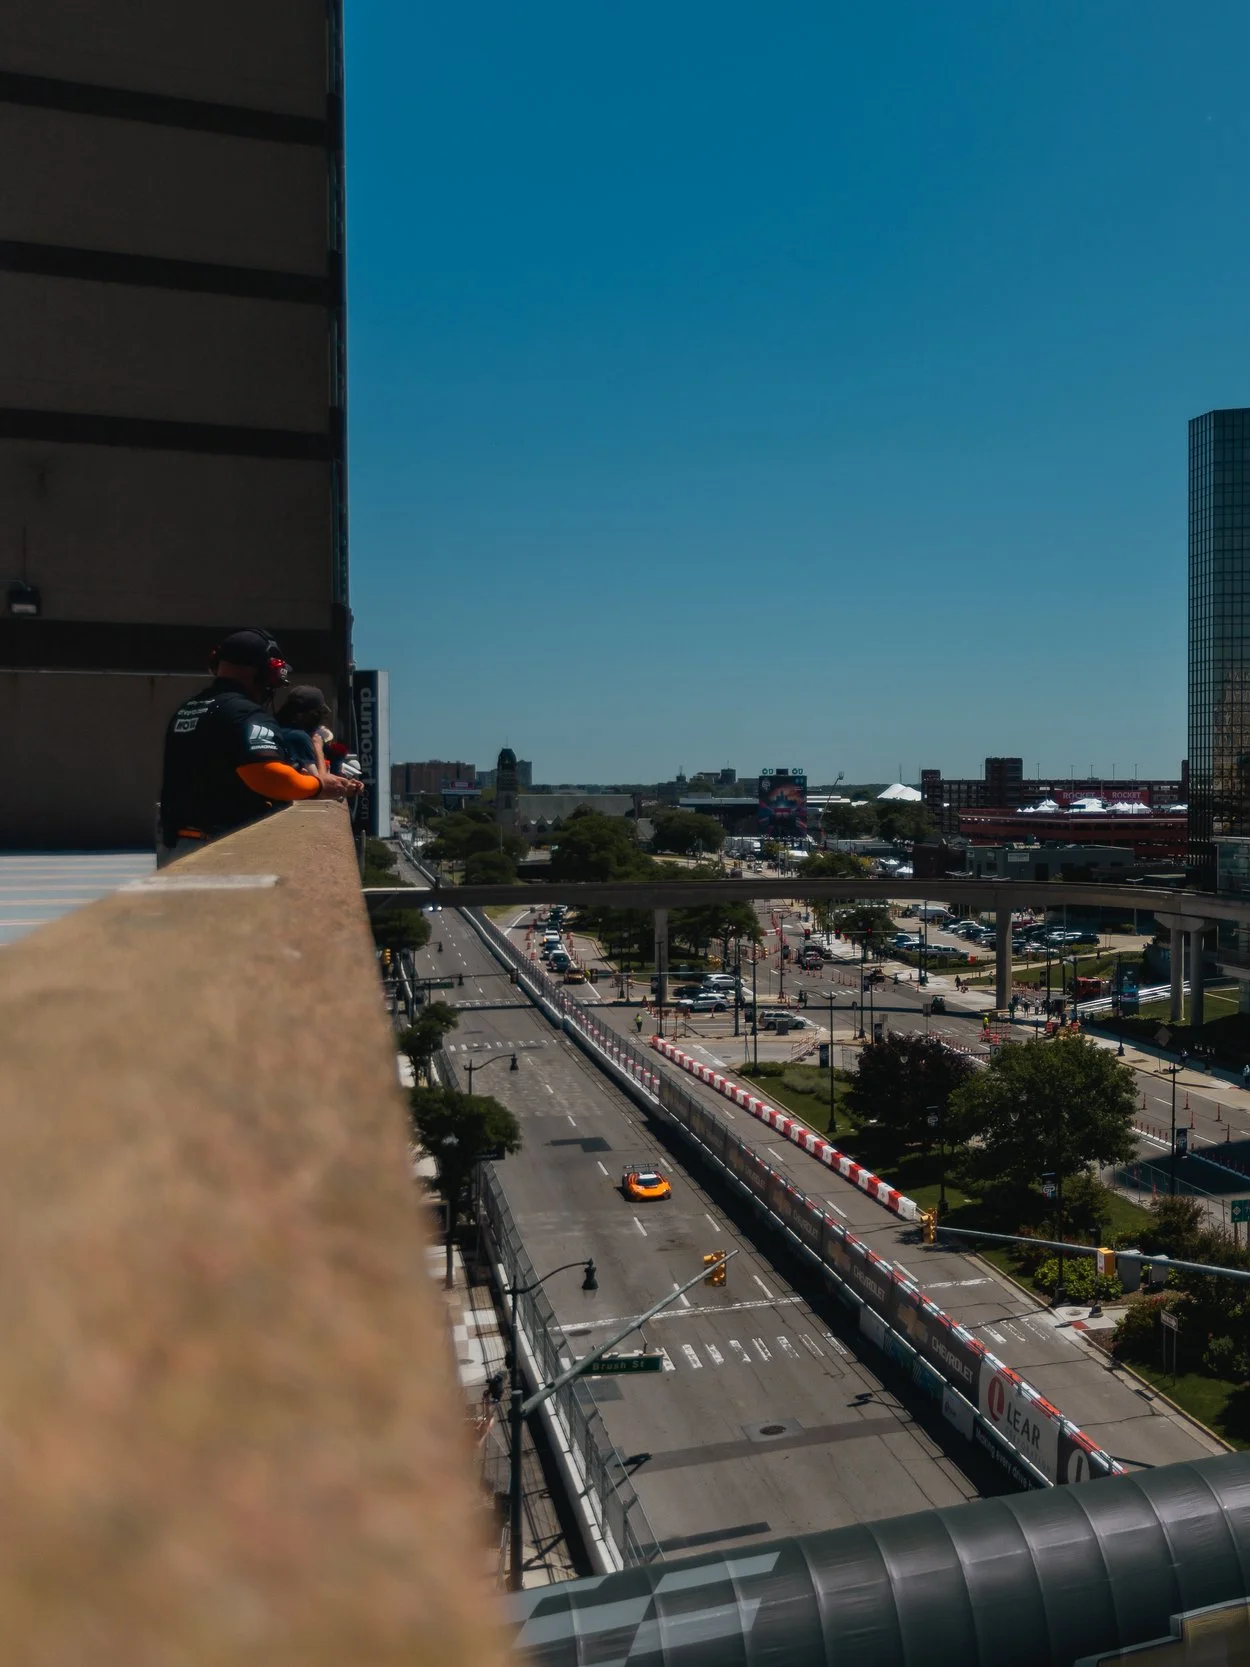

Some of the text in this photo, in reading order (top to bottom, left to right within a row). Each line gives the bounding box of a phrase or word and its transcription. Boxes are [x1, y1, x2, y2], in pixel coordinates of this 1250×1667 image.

[359, 687, 376, 820] dumoartcom
[1062, 791, 1096, 799] ROCKET
[1112, 791, 1142, 799] ROCKET
[853, 1264, 886, 1302] CHEVROLET
[591, 1359, 645, 1371] Brush St
[931, 1335, 974, 1384] CHEVROLET
[1006, 1401, 1041, 1449] LEAR
